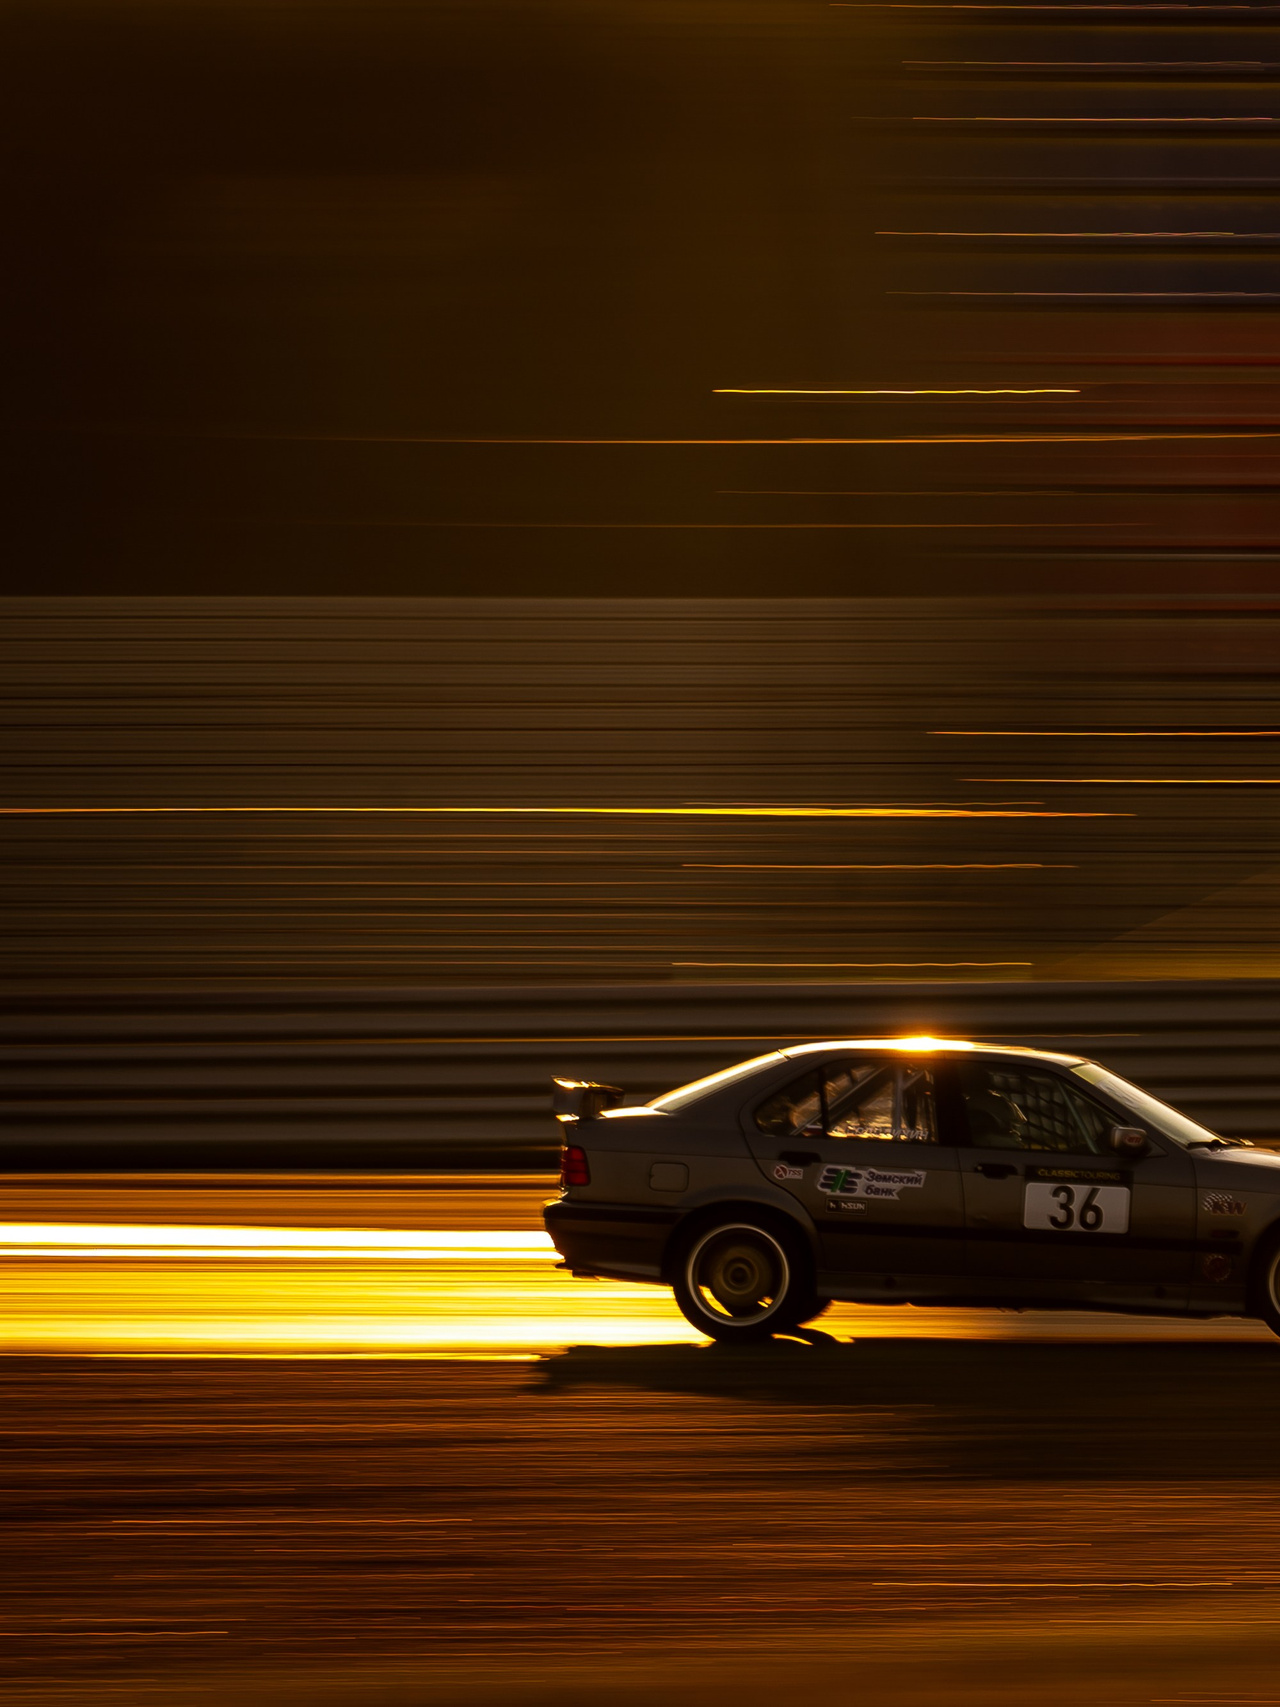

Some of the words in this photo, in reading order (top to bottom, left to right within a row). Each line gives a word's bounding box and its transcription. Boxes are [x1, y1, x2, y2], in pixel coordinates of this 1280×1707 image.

[865, 1170, 923, 1185] Земский
[865, 1184, 895, 1197] банк
[1049, 1185, 1104, 1231] 36
